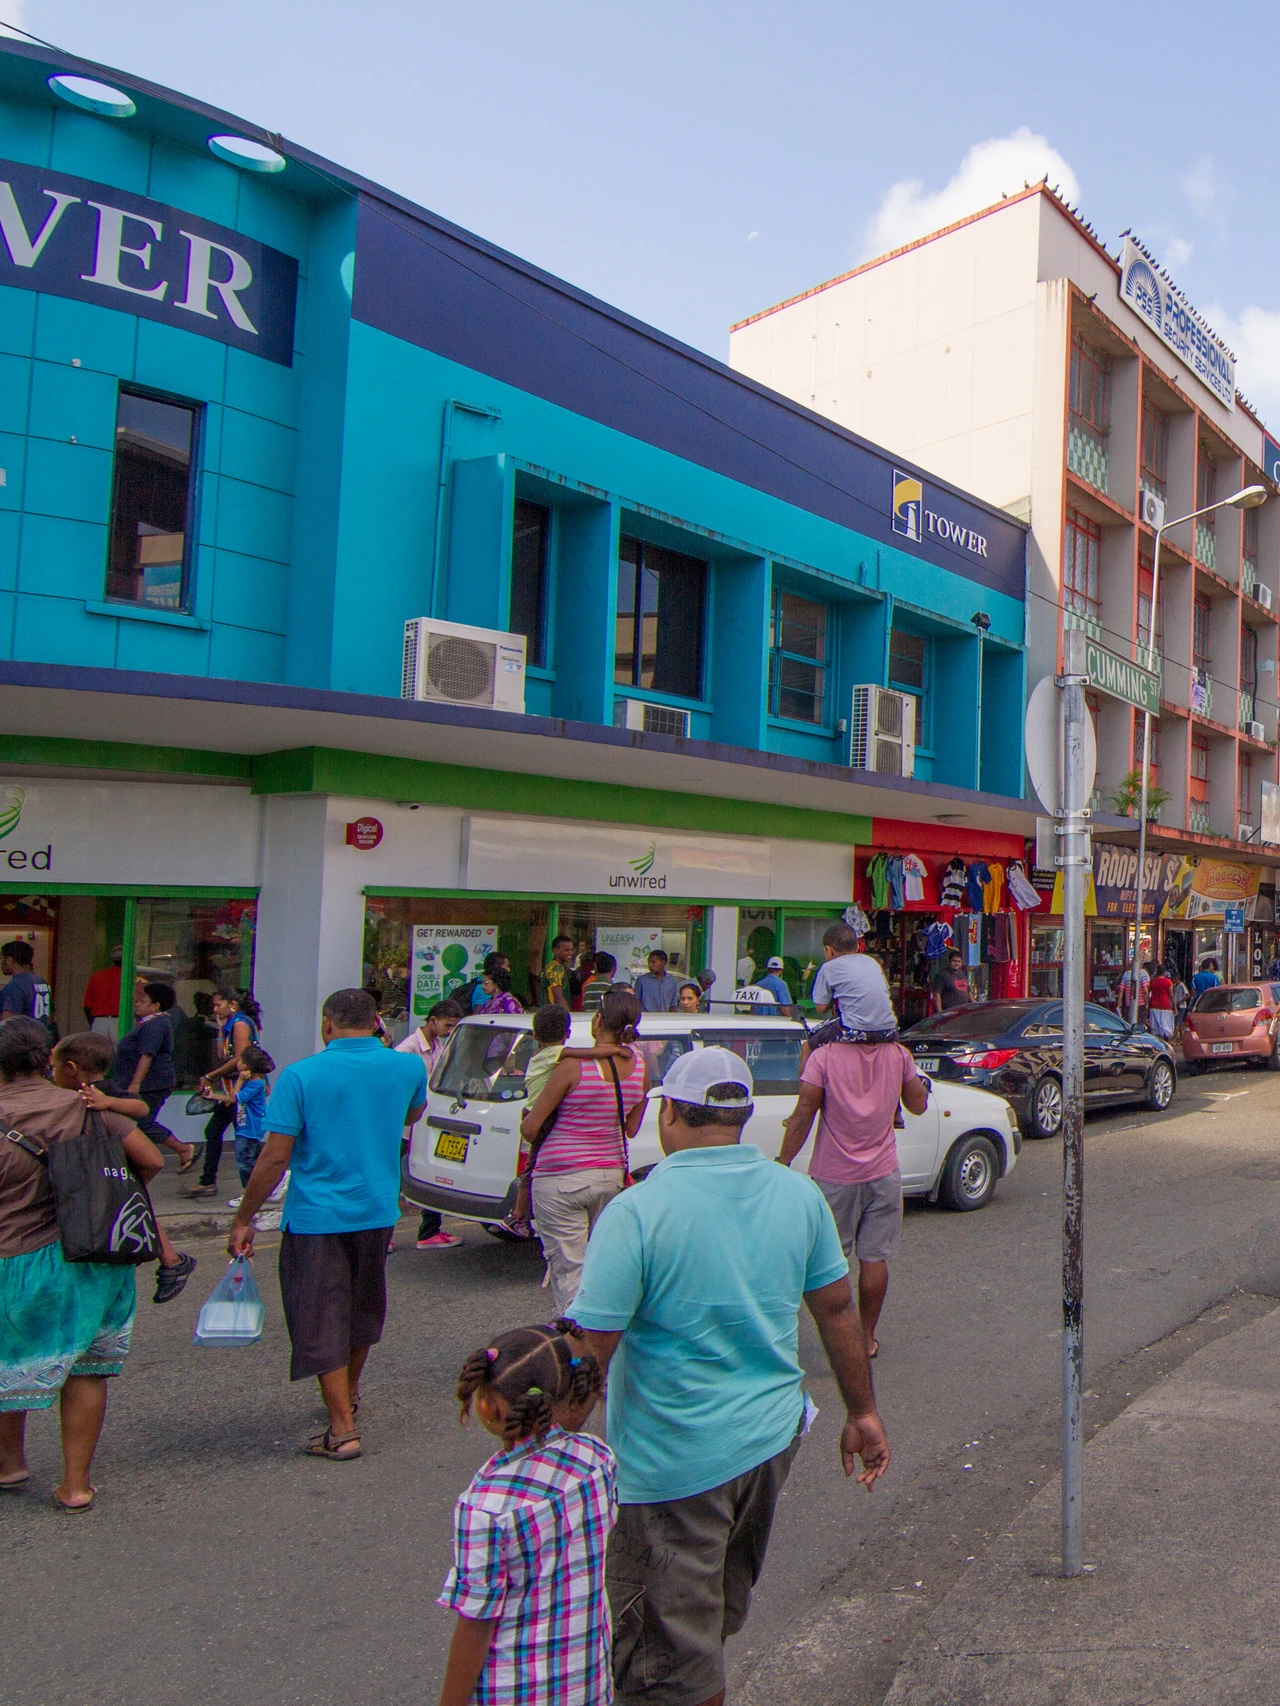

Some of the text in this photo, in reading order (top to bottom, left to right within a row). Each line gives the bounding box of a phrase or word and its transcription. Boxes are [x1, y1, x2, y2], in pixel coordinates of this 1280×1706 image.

[1165, 292, 1232, 385] PROFESSIONAL
[1164, 322, 1232, 404] SECURITY SERVICES LTD
[924, 510, 988, 558] TOWER
[500, 645, 523, 653] Panasonic
[1087, 646, 1158, 706] CUMMING ST
[1097, 851, 1162, 890] ROOPSH
[609, 874, 667, 889] unwired
[1106, 901, 1118, 912] FOR
[417, 929, 482, 938] GET REWARDED
[602, 934, 634, 943] UNLEASH
[417, 980, 440, 988] DATA
[735, 990, 760, 1001] TAXI
